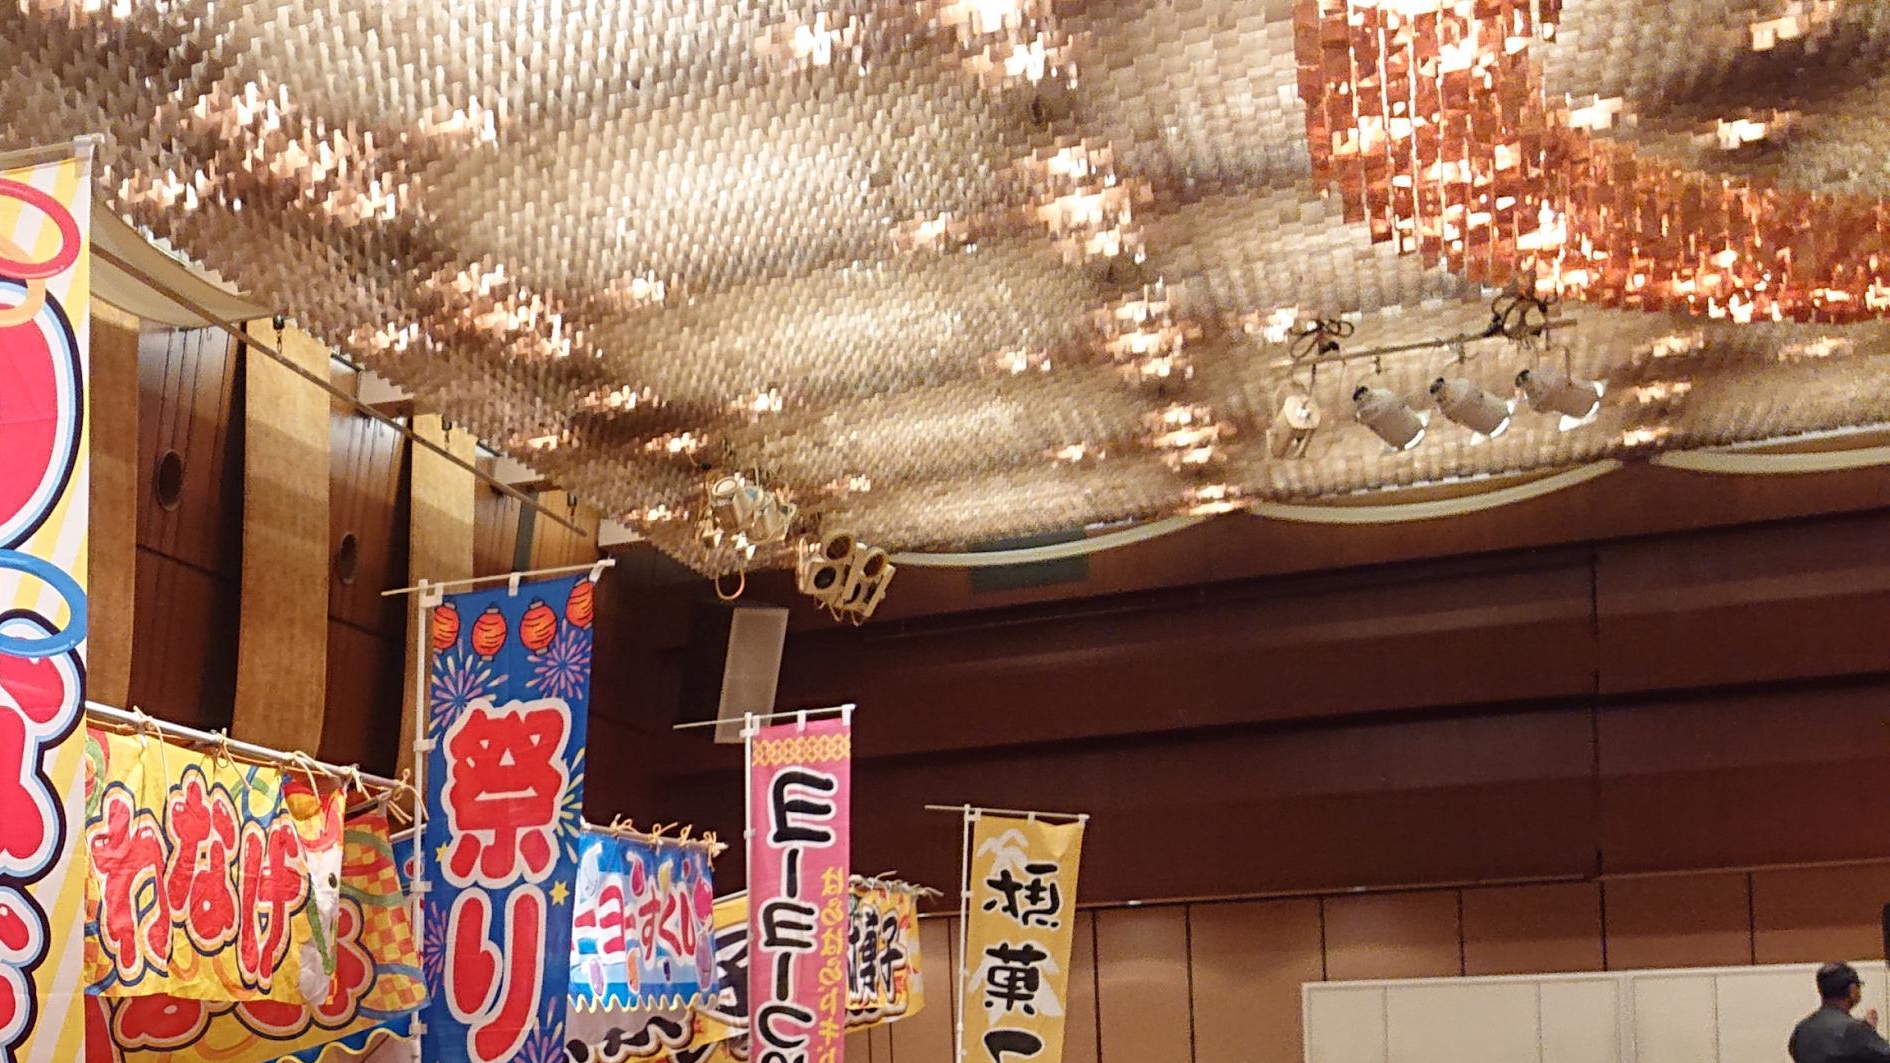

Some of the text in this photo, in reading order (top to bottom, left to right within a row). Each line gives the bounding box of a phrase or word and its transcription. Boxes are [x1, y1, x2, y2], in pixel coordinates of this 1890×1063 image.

[445, 704, 566, 1063] 祭り
[571, 883, 698, 962] ーヨーすくい
